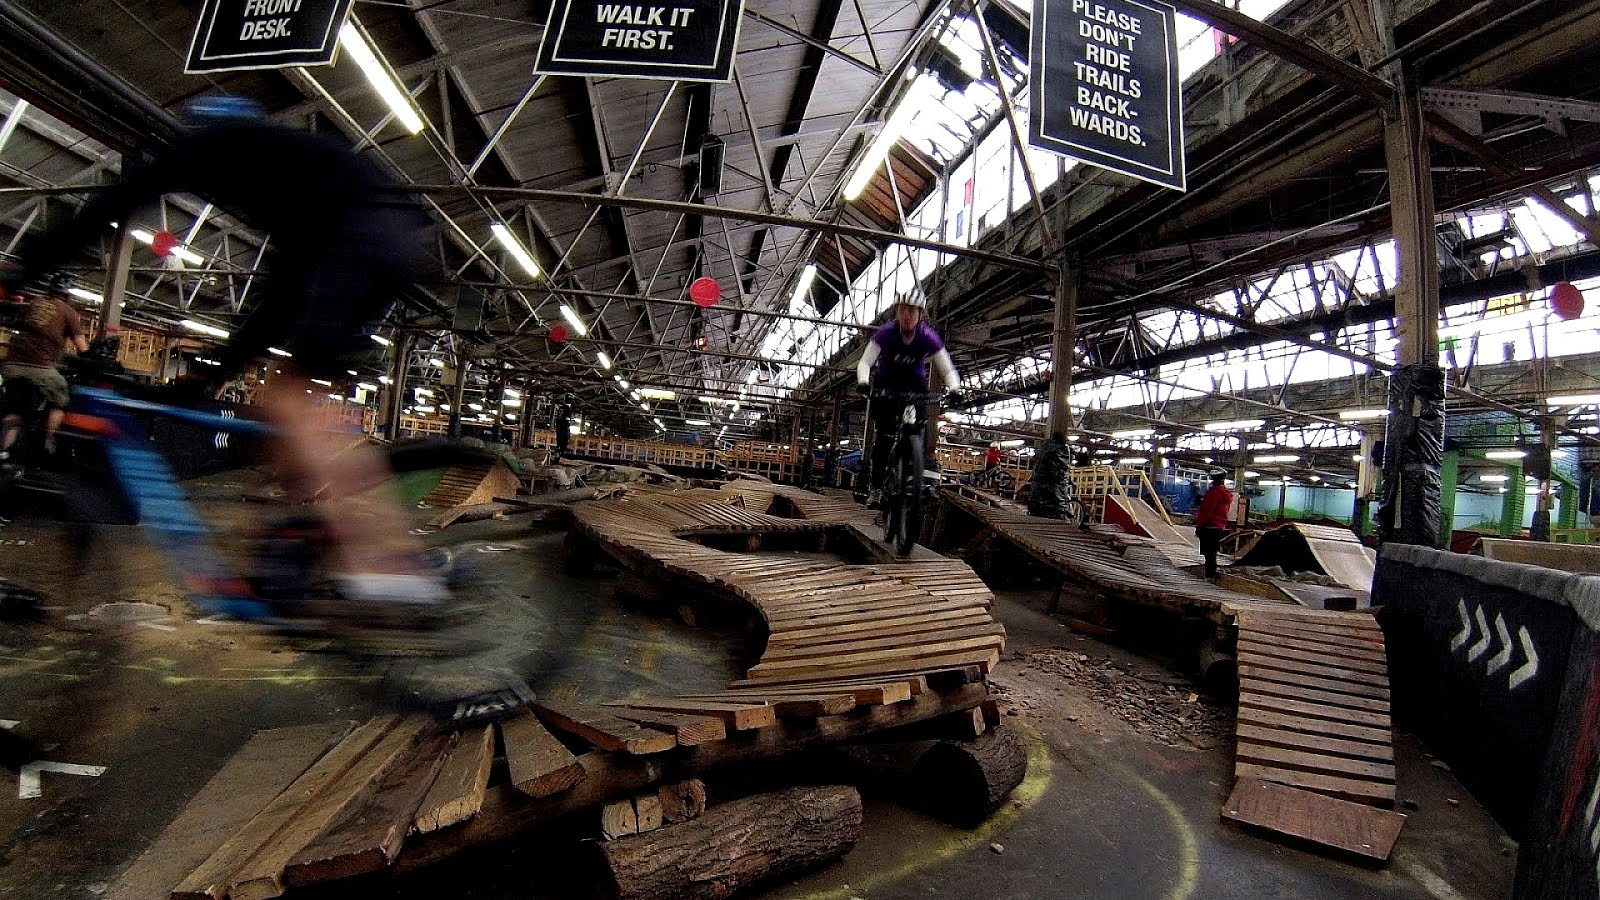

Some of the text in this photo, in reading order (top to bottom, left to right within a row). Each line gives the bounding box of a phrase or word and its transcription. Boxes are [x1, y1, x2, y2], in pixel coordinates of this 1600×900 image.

[244, 0, 301, 17] FRONT
[597, 5, 695, 27] WALK IT
[1072, 0, 1141, 35] PLEASE
[240, 18, 291, 40] DESK.
[601, 29, 674, 50] FIRST.
[1080, 20, 1135, 51] DON'T
[1086, 43, 1131, 73] RIDE
[1074, 61, 1141, 99] TRAILS
[1077, 86, 1138, 120] BACK-
[1069, 106, 1146, 146] WARDS.
